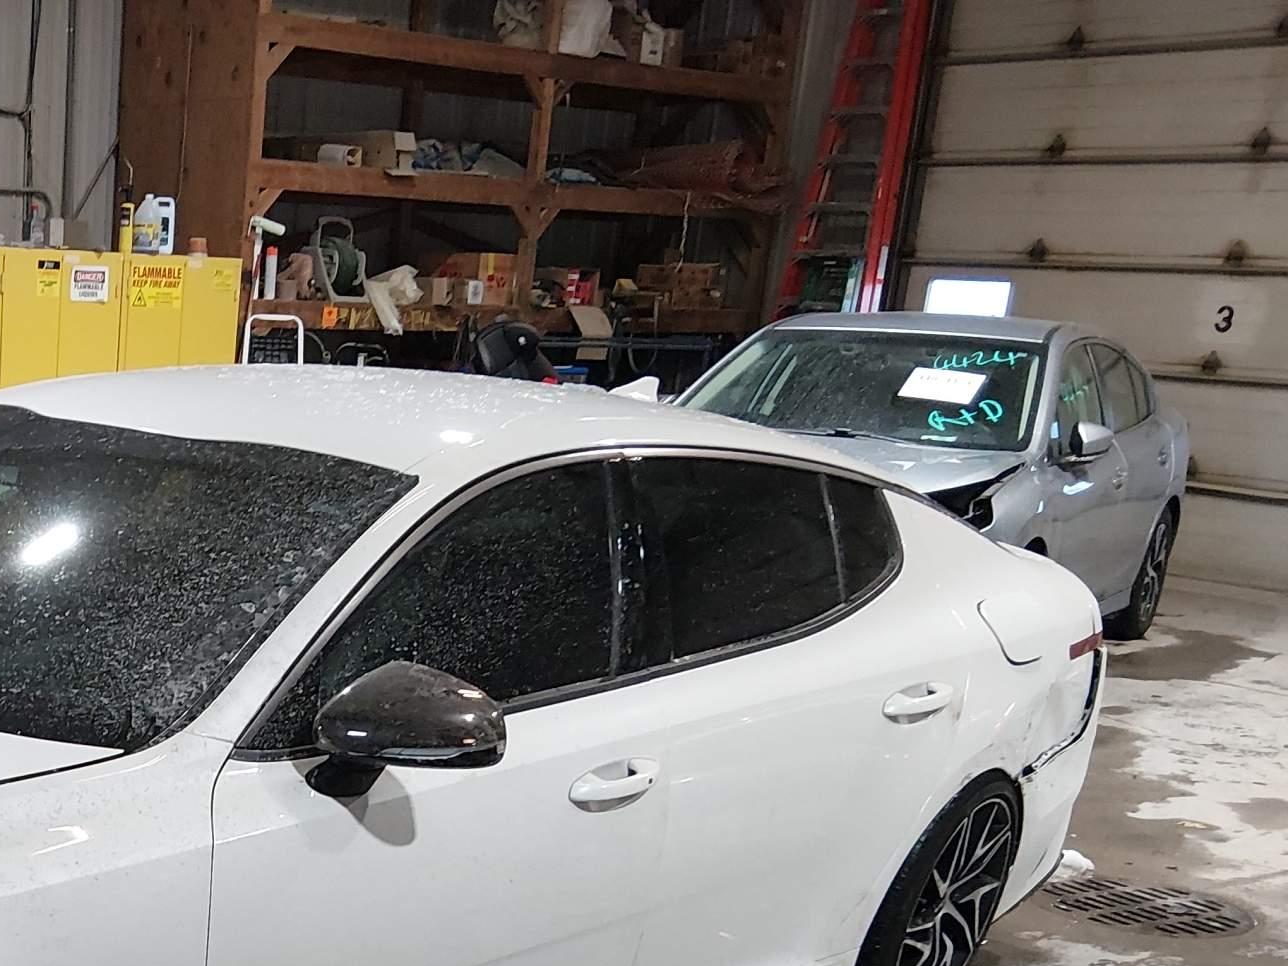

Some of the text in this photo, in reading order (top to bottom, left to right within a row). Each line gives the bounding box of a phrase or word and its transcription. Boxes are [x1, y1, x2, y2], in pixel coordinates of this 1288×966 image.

[77, 272, 104, 282] DANGER
[133, 266, 182, 279] FLAMMABLE
[133, 279, 180, 288] KEEP FIRE AWAY
[1214, 305, 1234, 333] 3
